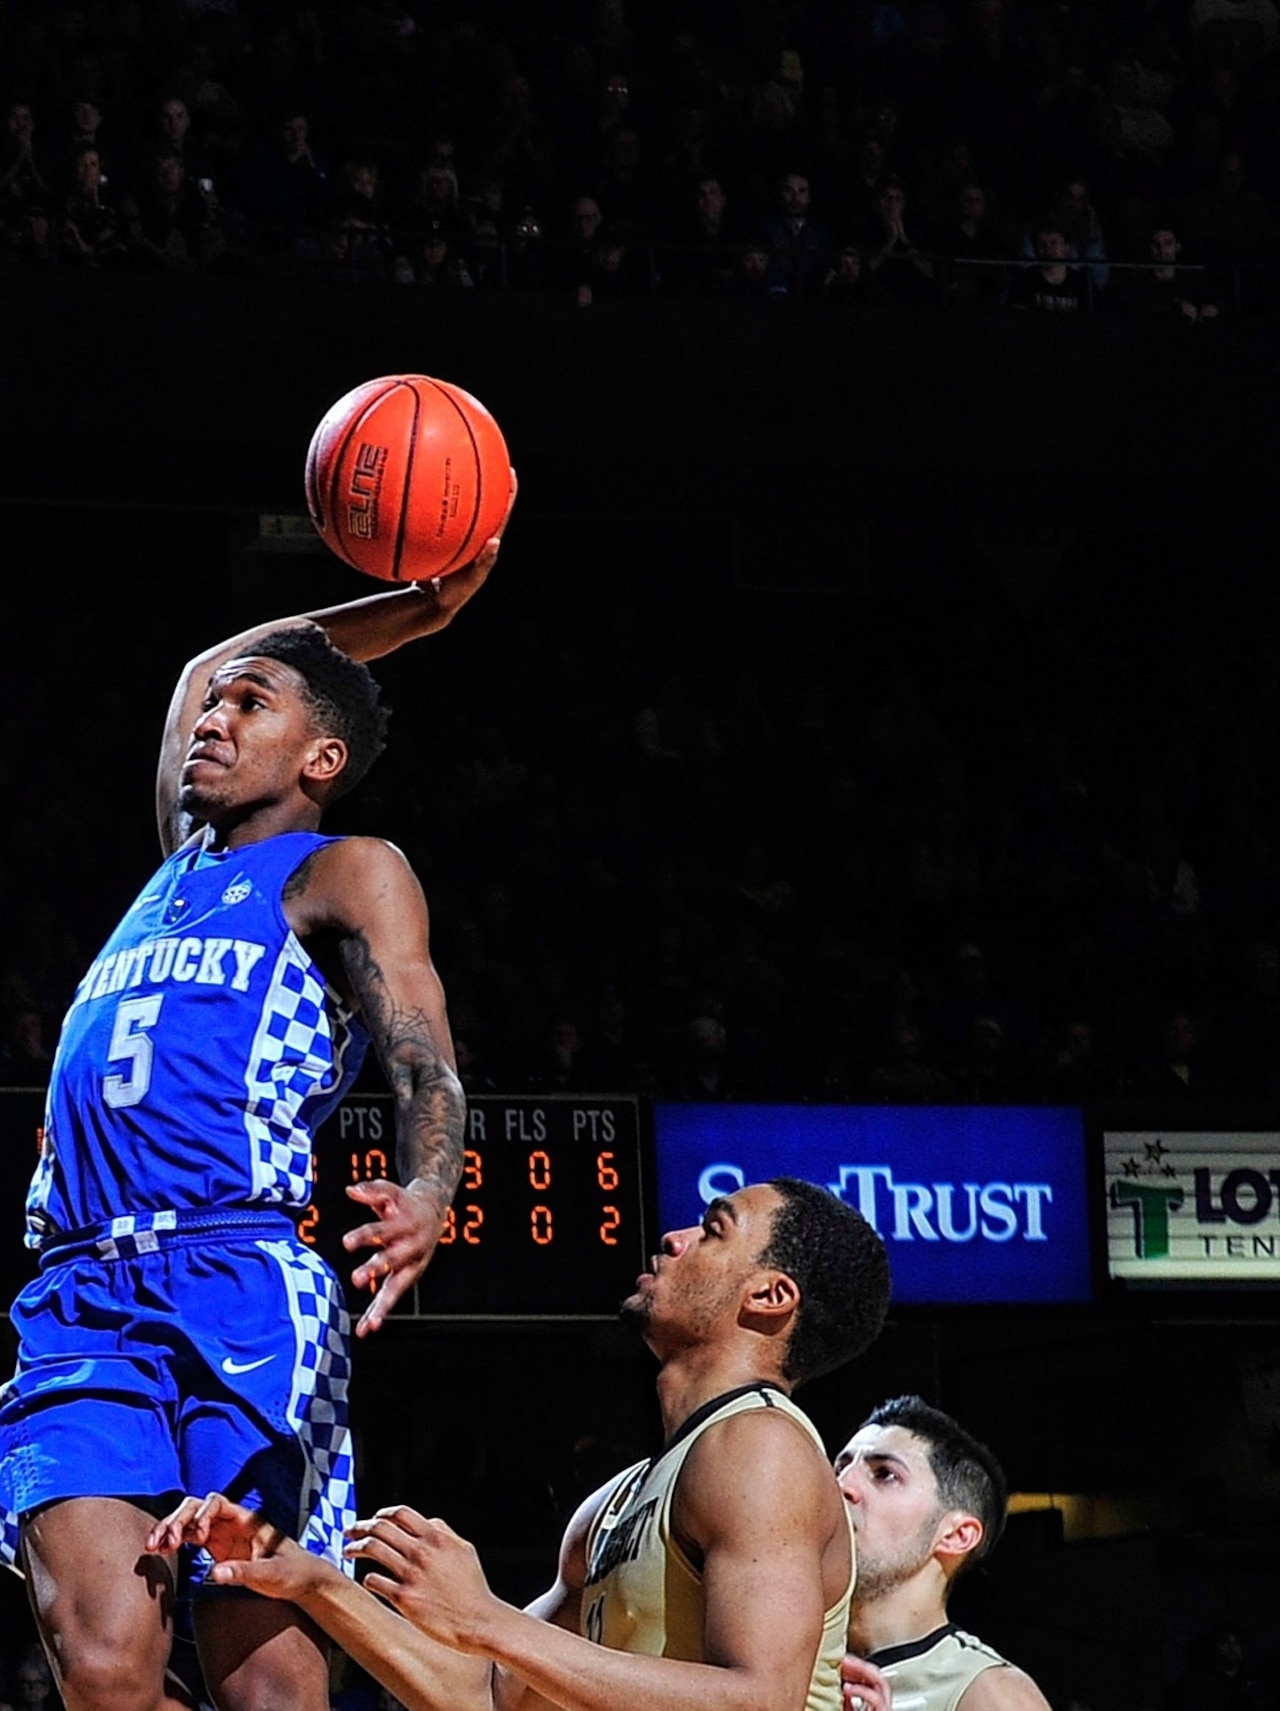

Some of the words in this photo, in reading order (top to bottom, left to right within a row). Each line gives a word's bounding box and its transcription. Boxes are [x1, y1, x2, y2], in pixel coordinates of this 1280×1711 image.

[102, 992, 164, 1109] 5
[339, 1106, 383, 1141] PTS
[505, 1109, 547, 1142] FLS
[573, 1109, 616, 1142] PTS
[528, 1150, 551, 1191] 0
[596, 1151, 619, 1191] 6
[530, 1205, 553, 1245] 0
[599, 1205, 621, 1246] 2
